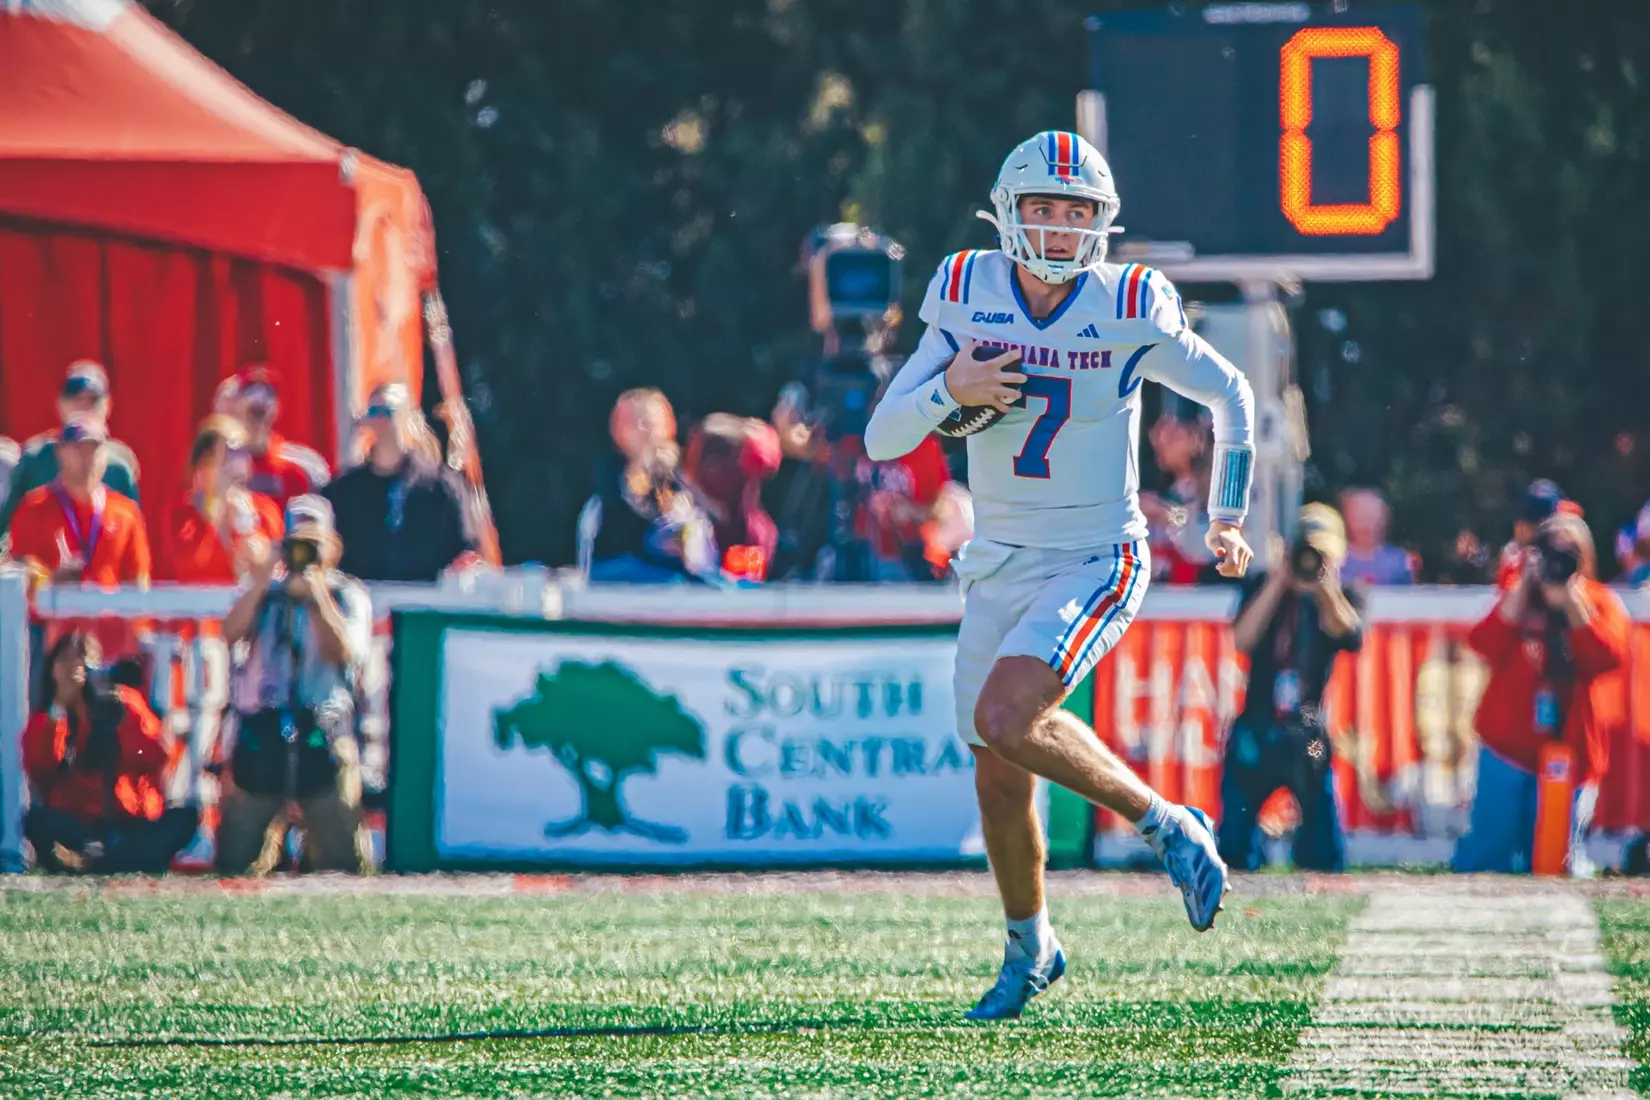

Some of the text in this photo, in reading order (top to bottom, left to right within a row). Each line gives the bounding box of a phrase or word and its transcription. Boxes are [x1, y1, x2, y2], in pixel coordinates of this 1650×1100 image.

[1279, 26, 1400, 235] 0
[1067, 350, 1112, 370] TECH
[1013, 374, 1072, 479] 7
